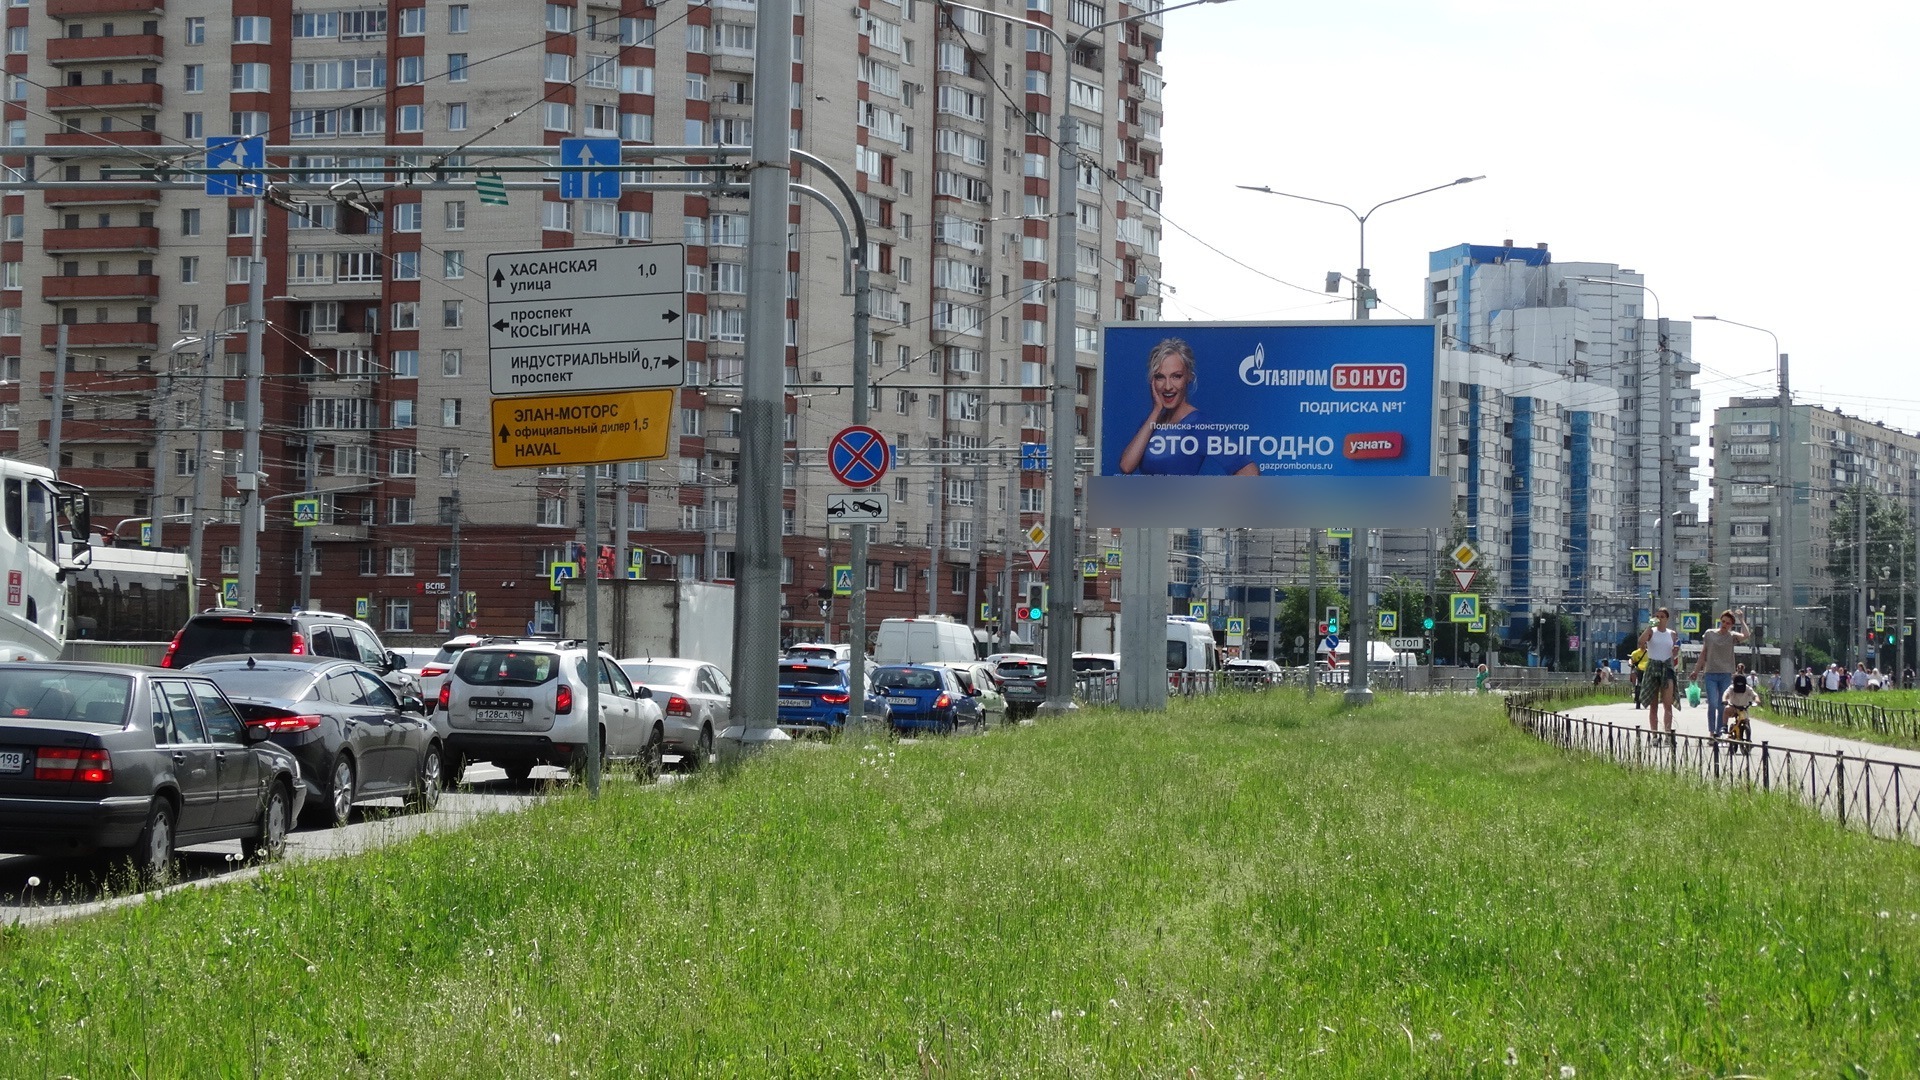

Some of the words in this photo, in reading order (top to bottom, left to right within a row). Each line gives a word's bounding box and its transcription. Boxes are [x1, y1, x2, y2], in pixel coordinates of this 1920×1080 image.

[510, 259, 597, 276] ХАСАНСКАЯ
[638, 263, 657, 278] 1,0
[510, 278, 551, 294] улица
[510, 308, 573, 322] проспект
[510, 322, 591, 338] КОСЫГИНА
[511, 348, 640, 370] ИНДУСТРИАЛЬНЫЙ
[641, 357, 660, 371] 0,7
[511, 371, 573, 386] проспект
[1265, 369, 1328, 386] ГАЗПРОМ
[1336, 369, 1401, 386] БОНУС
[514, 404, 619, 422] ЭЛАН-МОТОРС
[1300, 401, 1378, 415] ПОДПИСКА
[514, 422, 598, 438] официальный
[600, 422, 630, 434] дилер
[633, 418, 649, 432] 1,5
[1150, 422, 1249, 431] Подписка-конструктор
[515, 443, 561, 457] HAVAL
[1149, 436, 1199, 455] ЭТО
[1207, 436, 1335, 460] ВЫГОДНО
[1350, 440, 1392, 454] узнать
[1259, 462, 1333, 472] gazprombonus.ru
[425, 582, 446, 590] БСПБ
[1395, 639, 1419, 647] СТОП
[0, 754, 20, 764] 198
